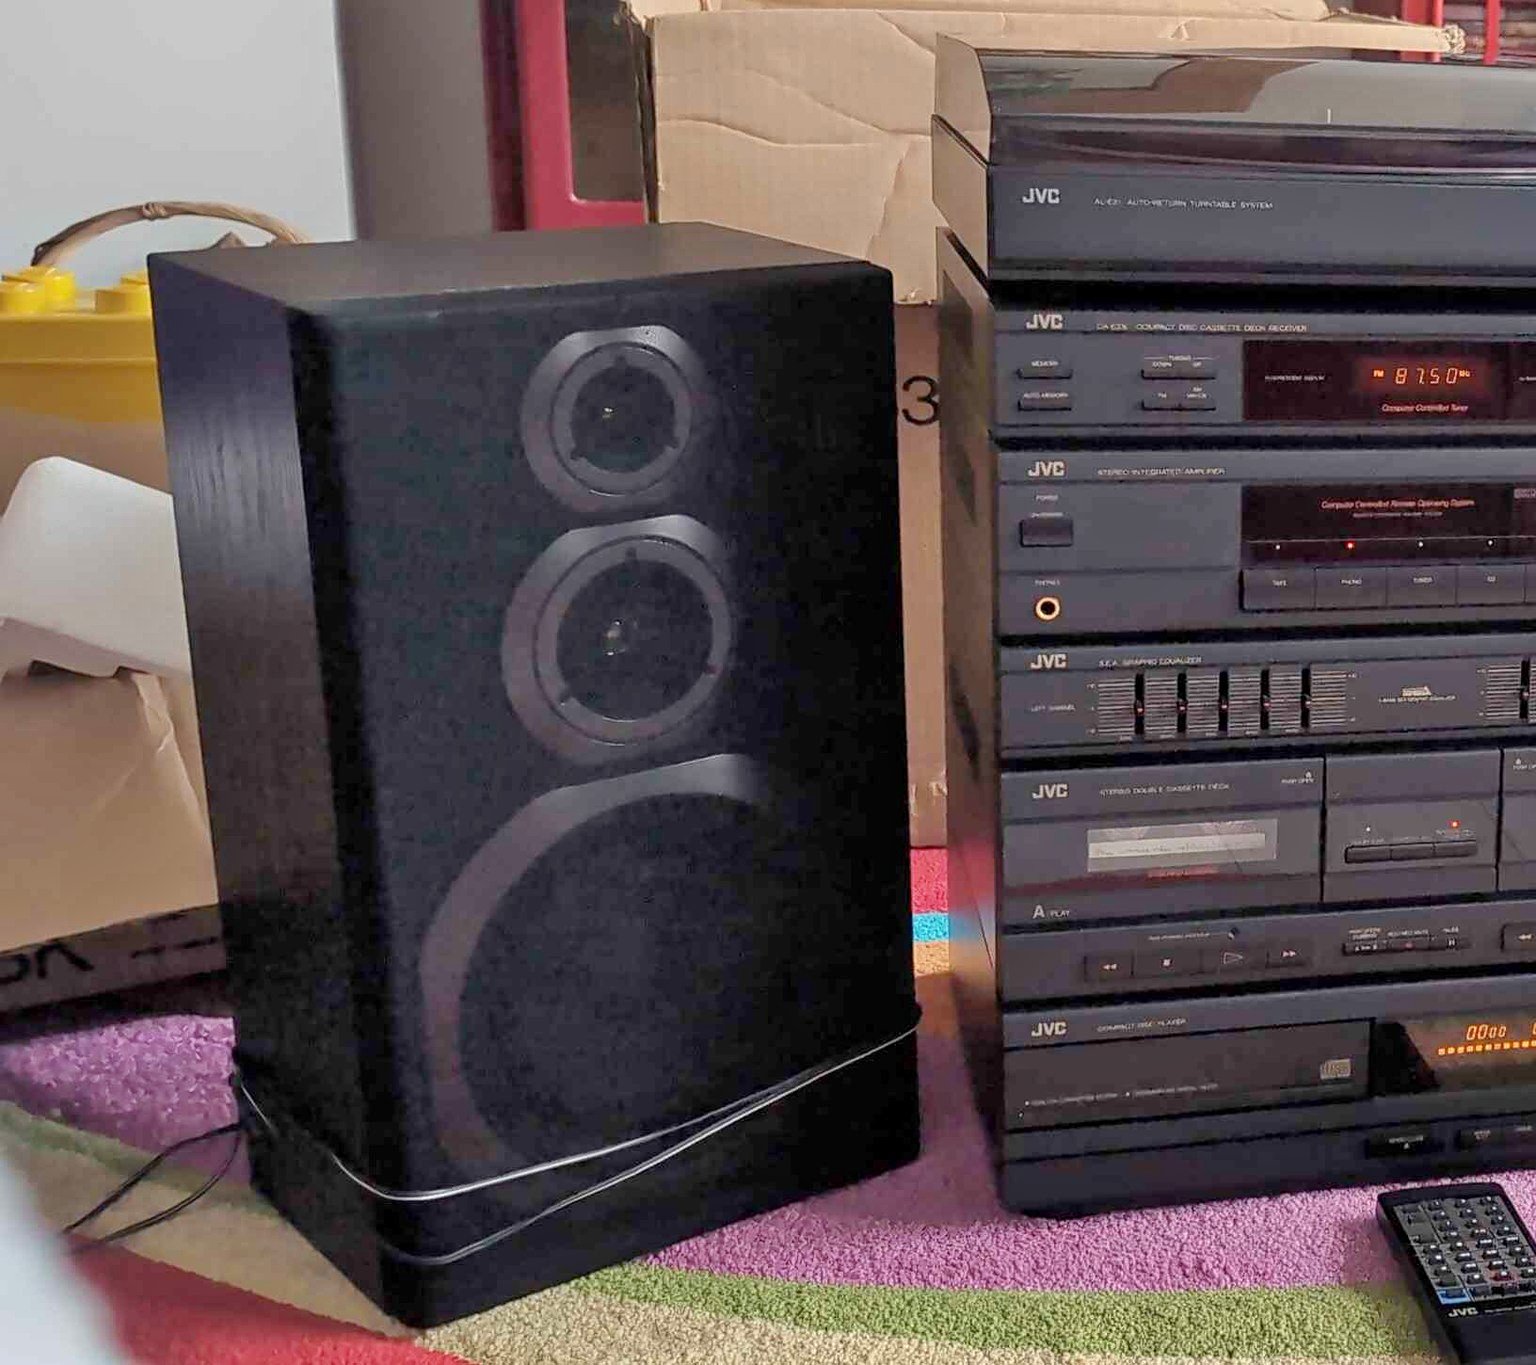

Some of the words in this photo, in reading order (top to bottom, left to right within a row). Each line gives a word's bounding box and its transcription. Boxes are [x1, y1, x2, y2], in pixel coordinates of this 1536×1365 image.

[1022, 187, 1060, 204] JVC
[1189, 200, 1236, 209] TURNTABLE
[1240, 201, 1274, 209] SYSTEM
[1026, 314, 1063, 331] JVC
[1136, 323, 1175, 332] COMPACT
[1178, 323, 1197, 332] DISC
[1199, 324, 1241, 332] CASSETTE
[1381, 403, 1414, 413] Computer
[1415, 403, 1449, 413] Controlled
[1028, 461, 1065, 477] JVC
[1098, 467, 1130, 476] STEREO
[1184, 466, 1226, 476] AMPLIFIER
[1030, 653, 1067, 669] JVC
[1160, 656, 1202, 666] EQUALIZER
[1032, 783, 1069, 800] JVC
[1100, 788, 1131, 796] STEREO
[1133, 786, 1163, 795] DOUBLE
[1166, 785, 1205, 793] CASSETTE
[1032, 904, 1045, 920] A
[1031, 1021, 1068, 1037] JVC
[1097, 1024, 1135, 1033] COMPACT
[1157, 1018, 1187, 1027] PLAYER
[1448, 1307, 1479, 1318] JVC
